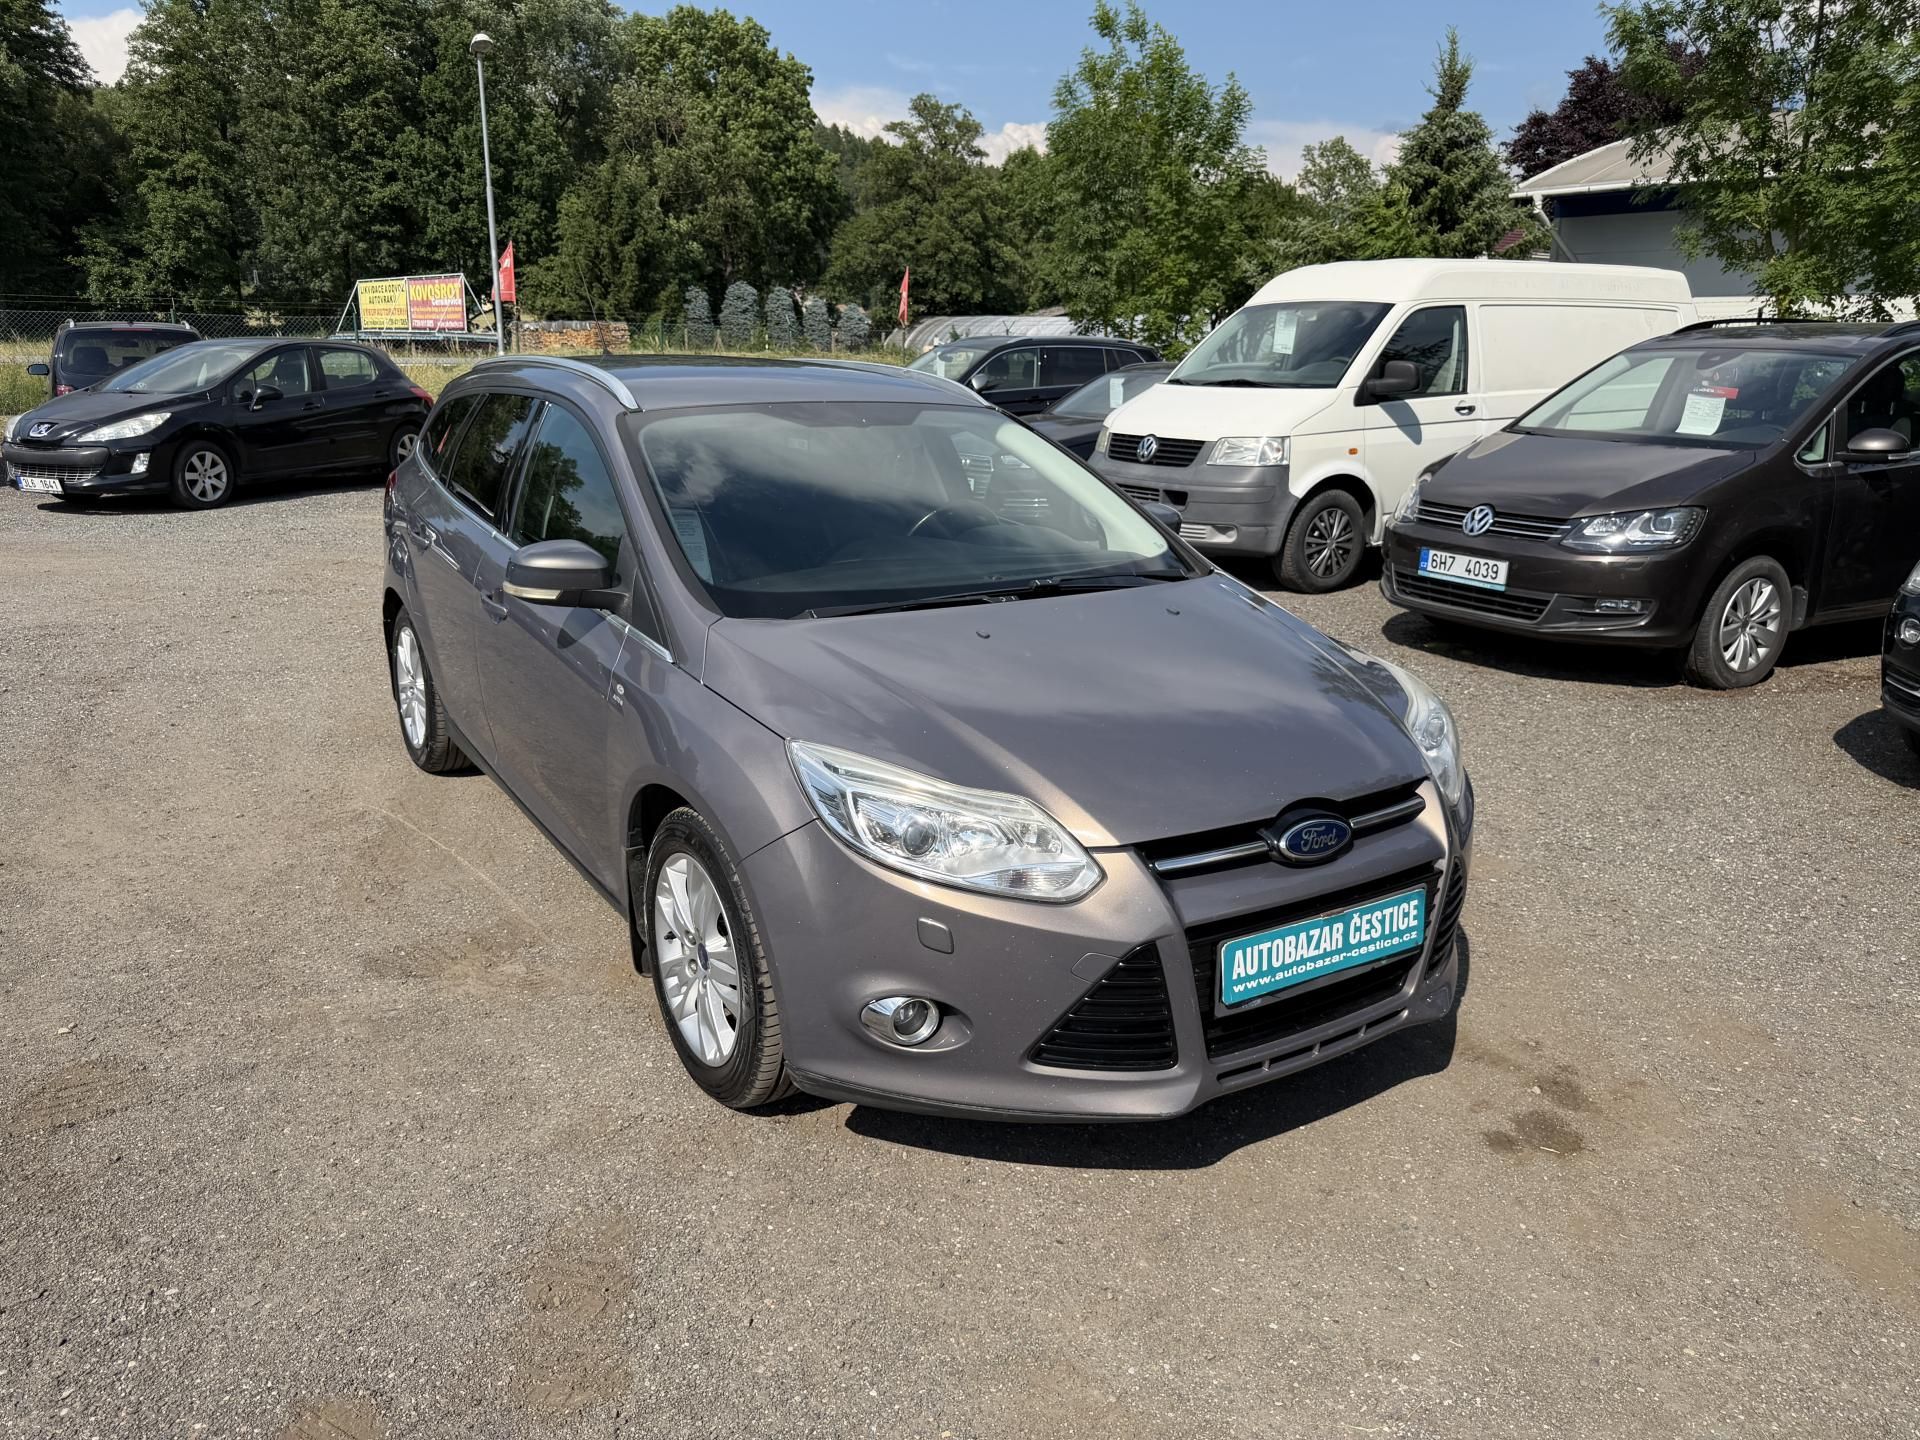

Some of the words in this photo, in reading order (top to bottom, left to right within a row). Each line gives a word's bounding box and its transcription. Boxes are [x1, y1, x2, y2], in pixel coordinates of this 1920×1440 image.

[1431, 553, 1456, 572] 6H7
[1465, 559, 1499, 580] 4039
[1301, 825, 1338, 852] Ford
[1232, 922, 1344, 980] AUTOBAZAR
[1349, 900, 1418, 945] ČESTICE
[1233, 930, 1418, 993] www.autobazar-cestice.cz
